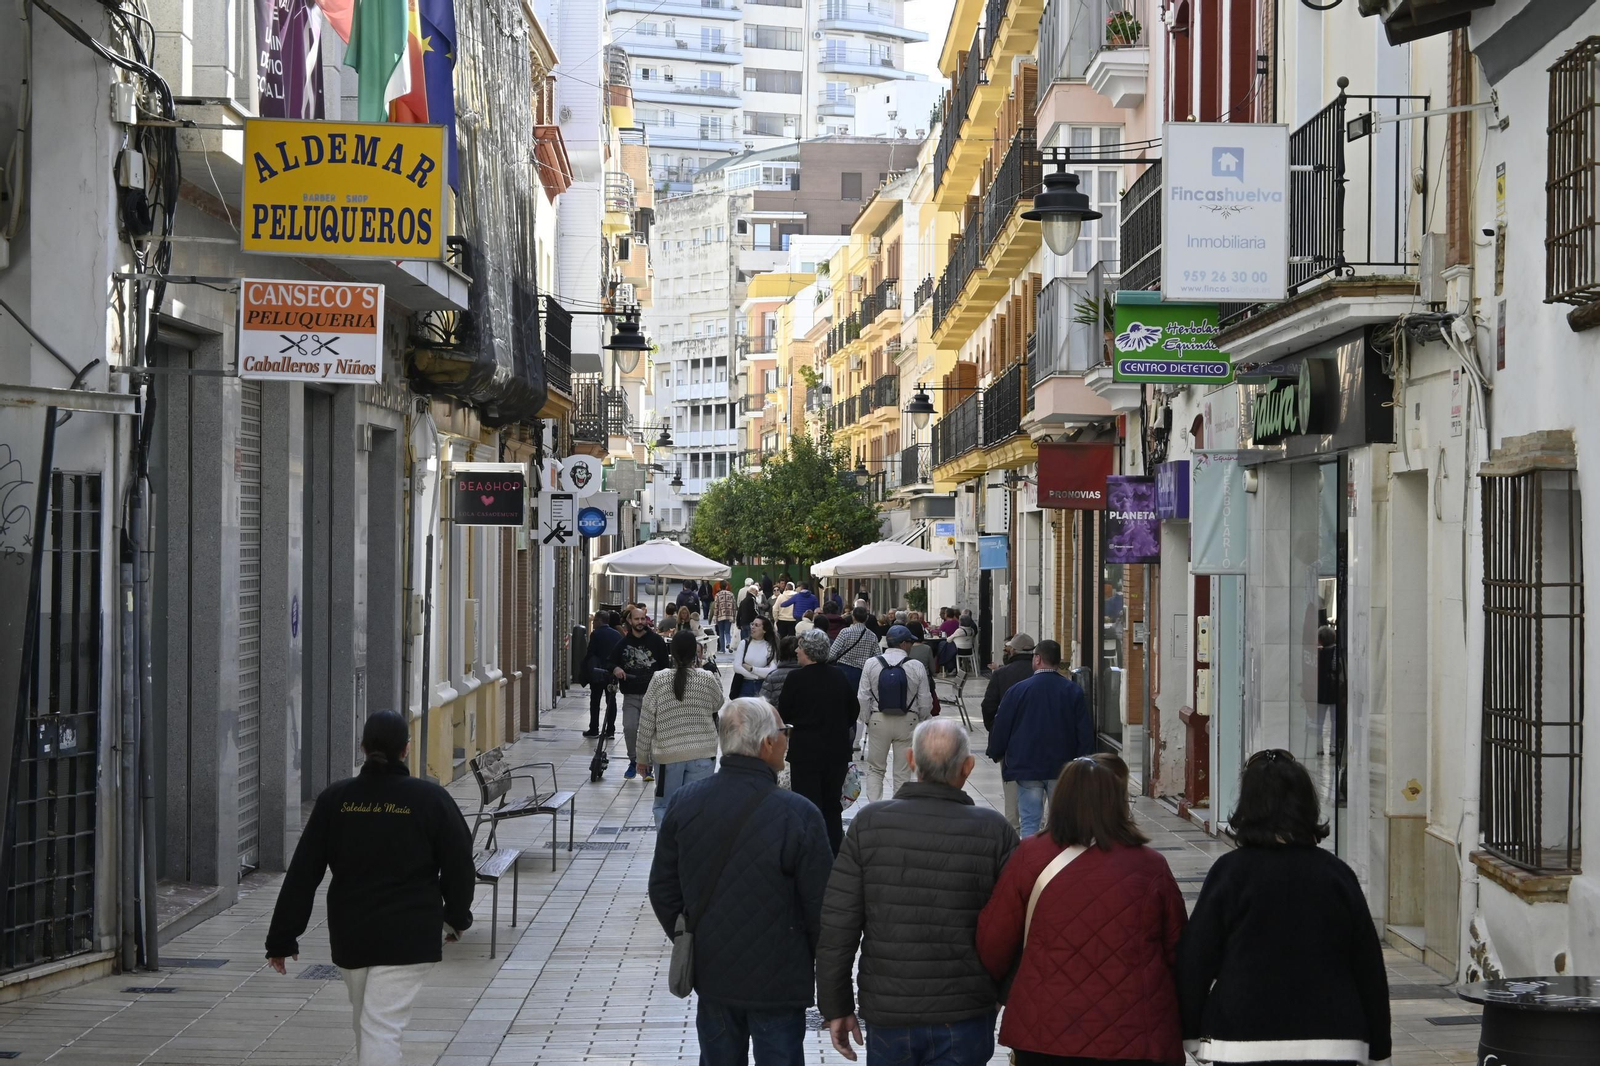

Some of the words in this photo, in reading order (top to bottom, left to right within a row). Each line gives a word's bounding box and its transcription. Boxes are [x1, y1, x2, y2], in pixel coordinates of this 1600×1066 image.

[253, 133, 435, 189] ALDEMAR
[302, 193, 336, 203] BARBER
[346, 194, 369, 203] SHOP
[1171, 186, 1283, 203] Fincashuelva
[251, 204, 432, 245] PELUQUEROS
[1187, 234, 1266, 250] Inmobiliaria
[1183, 270, 1207, 282] 959
[1211, 271, 1227, 283] 26
[1231, 272, 1248, 283] 30
[1252, 272, 1268, 284] 00
[246, 310, 376, 330] PELUQUERIA
[243, 355, 320, 374] Caballeros
[321, 362, 333, 378] y
[335, 358, 376, 375] Niños
[1124, 363, 1167, 373] CENTRO
[1170, 364, 1224, 374] DIETETICO
[459, 481, 521, 492] BEASHOP
[1049, 490, 1101, 499] PRONOVIAS
[1109, 511, 1156, 520] PLANETA
[1222, 464, 1231, 569] HERBOLARIO
[340, 801, 372, 813] Soledad
[372, 802, 382, 813] de
